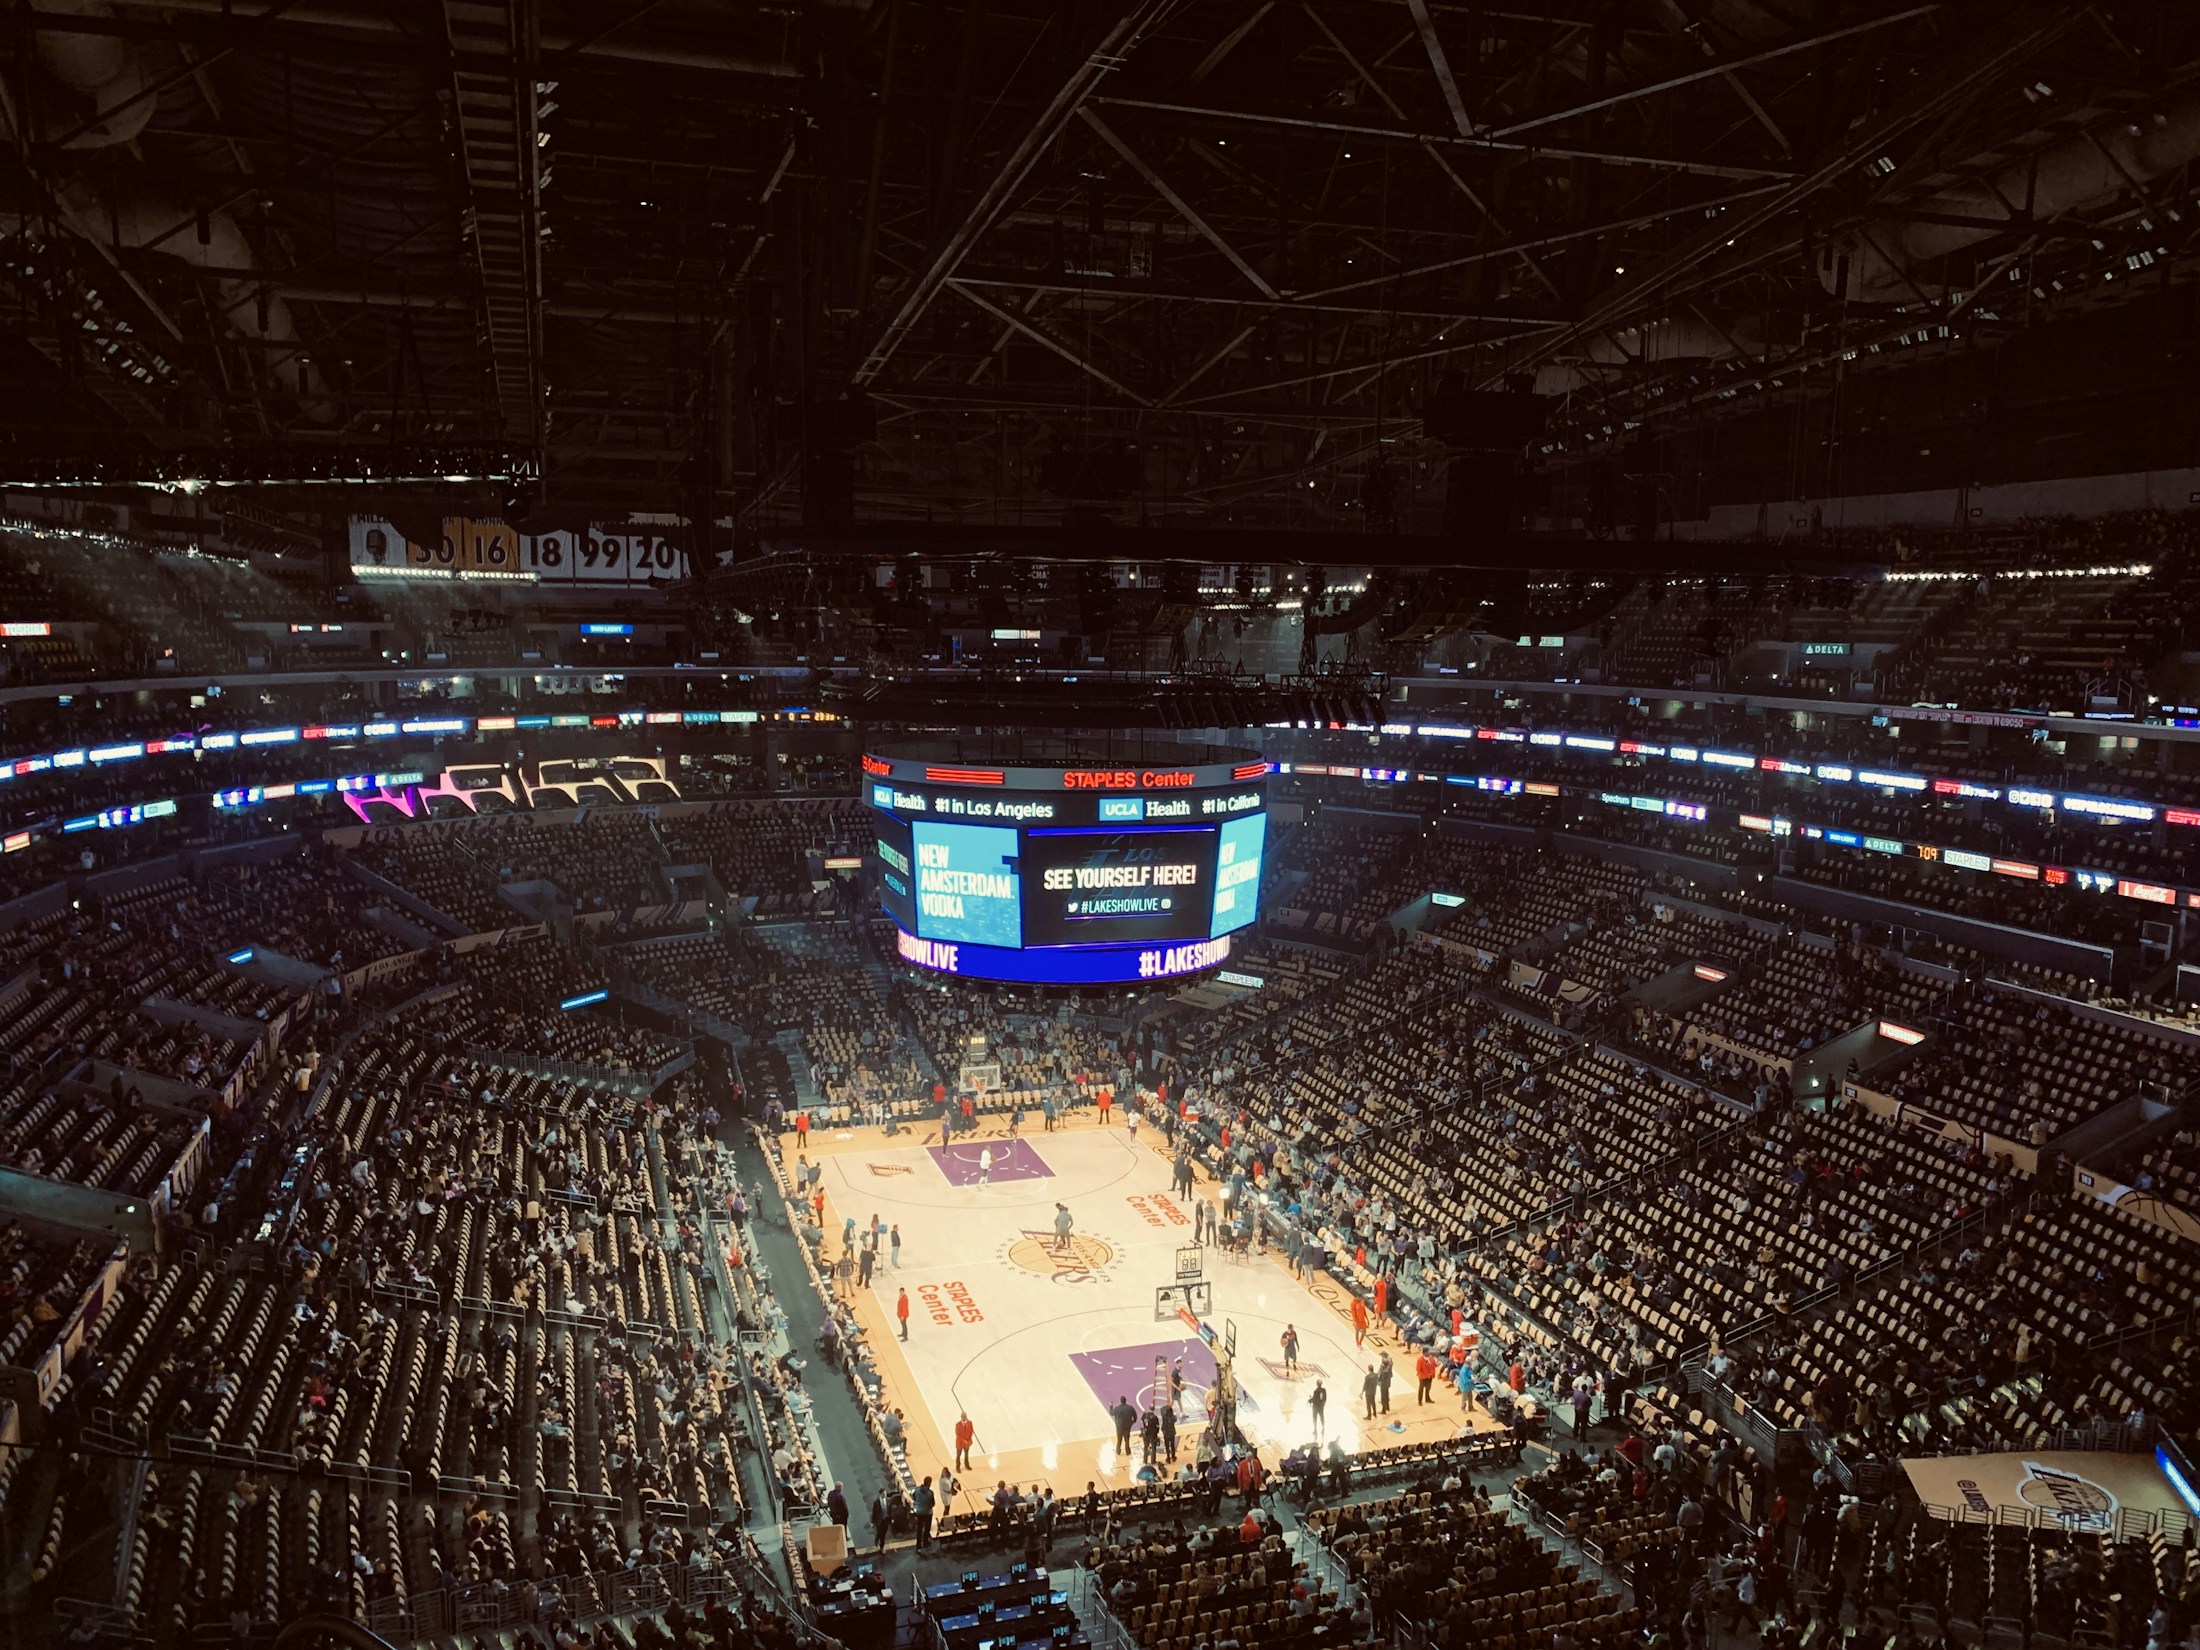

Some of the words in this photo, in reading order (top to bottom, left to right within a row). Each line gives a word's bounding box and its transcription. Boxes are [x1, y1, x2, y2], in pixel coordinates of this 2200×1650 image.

[475, 535, 506, 565] 16
[530, 537, 561, 567] 18
[583, 538, 620, 568] 99
[636, 537, 675, 569] 20
[6, 624, 47, 635] TOSHIBA
[1524, 637, 1555, 646] SLES
[1814, 644, 1844, 654] DELTA
[722, 713, 756, 721] STAPLES
[2000, 717, 2024, 728] 69050
[304, 728, 325, 738] ESPN
[868, 757, 892, 776] Center
[399, 774, 421, 783] DELTA
[1063, 771, 1137, 788] STAPLES
[1142, 771, 1195, 787] Center
[1935, 781, 1960, 794] ESPN
[875, 790, 890, 804] UCLA
[893, 792, 926, 811] Health
[934, 798, 950, 813] #1
[952, 799, 965, 814] in
[966, 799, 991, 816] Los
[994, 802, 1054, 820] Angeles
[1105, 803, 1138, 816] UCLA
[1146, 801, 1191, 817] Health
[1202, 798, 1216, 814] #1
[1217, 798, 1227, 813] in
[1228, 793, 1260, 812] California
[1601, 793, 1630, 805] Spectrum
[1840, 836, 1857, 845] LIGHT
[1873, 840, 1901, 852] DELTA
[918, 844, 950, 869] NEW
[1945, 851, 1988, 870] STAPLES
[1043, 869, 1074, 890] SEE
[1075, 866, 1151, 889] YOURSELF
[1153, 864, 1197, 886] HERE!
[2046, 869, 2065, 878] TIME
[2046, 876, 2064, 884] OUTS
[920, 893, 965, 919] VODKA
[1081, 898, 1159, 914] #LAKESHOWLIVE
[1223, 973, 1254, 985] STAPLES
[1126, 1195, 1167, 1228] Center
[1148, 1193, 1191, 1226] STAPLES
[917, 1285, 954, 1326] Center
[943, 1281, 984, 1323] STAPLES
